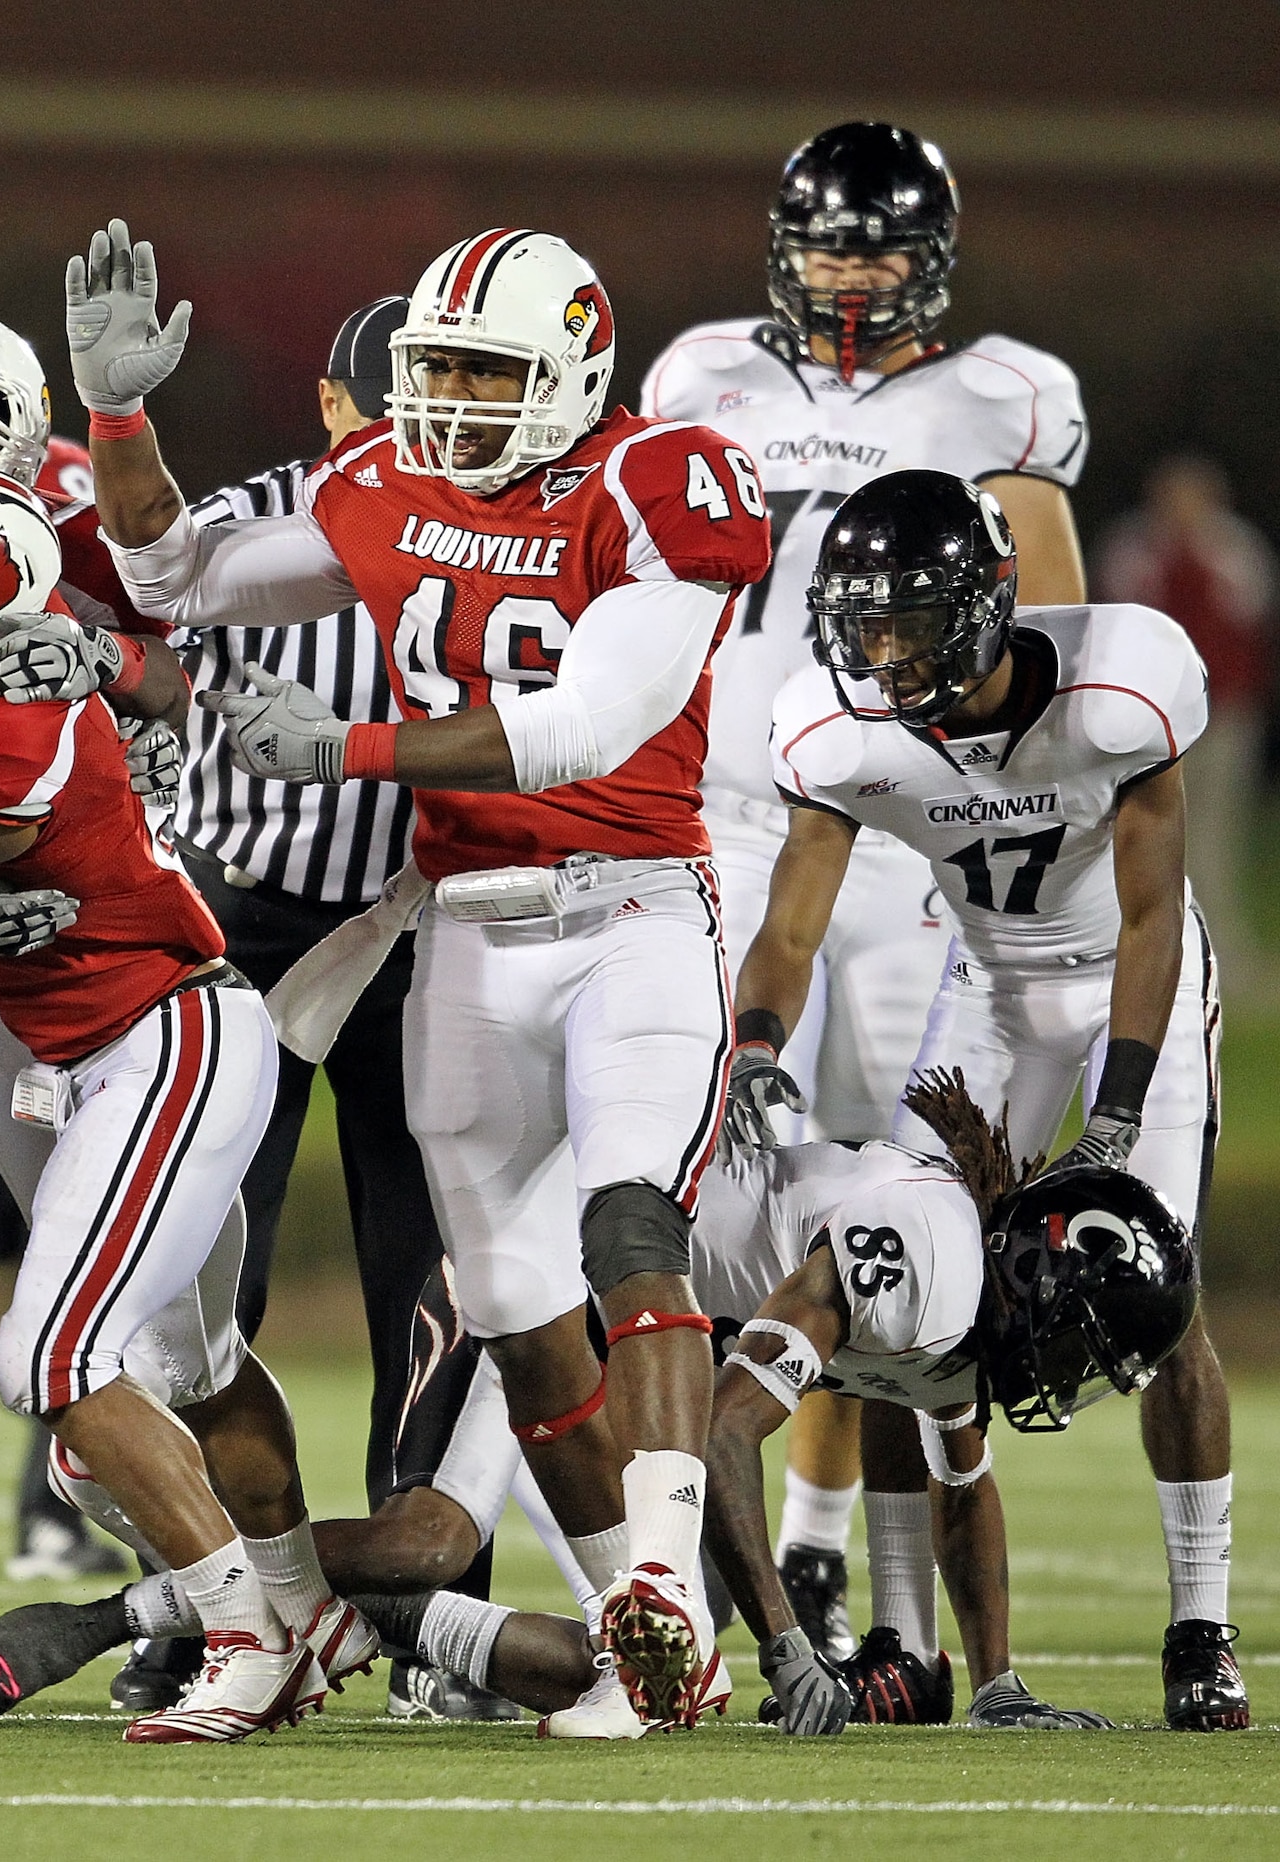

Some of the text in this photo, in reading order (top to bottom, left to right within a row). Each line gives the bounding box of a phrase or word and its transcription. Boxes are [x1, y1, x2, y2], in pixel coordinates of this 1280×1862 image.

[763, 437, 888, 469] CINCINNATI
[685, 446, 767, 521] 46
[392, 514, 569, 578] LOUISVILLE
[393, 573, 575, 720] 46
[961, 754, 999, 766] adidas
[928, 793, 1058, 823] CINCINNATI
[942, 823, 1069, 915] 17
[844, 1224, 905, 1298] 85
[776, 1361, 803, 1386] adidas
[161, 1581, 181, 1621] adidas
